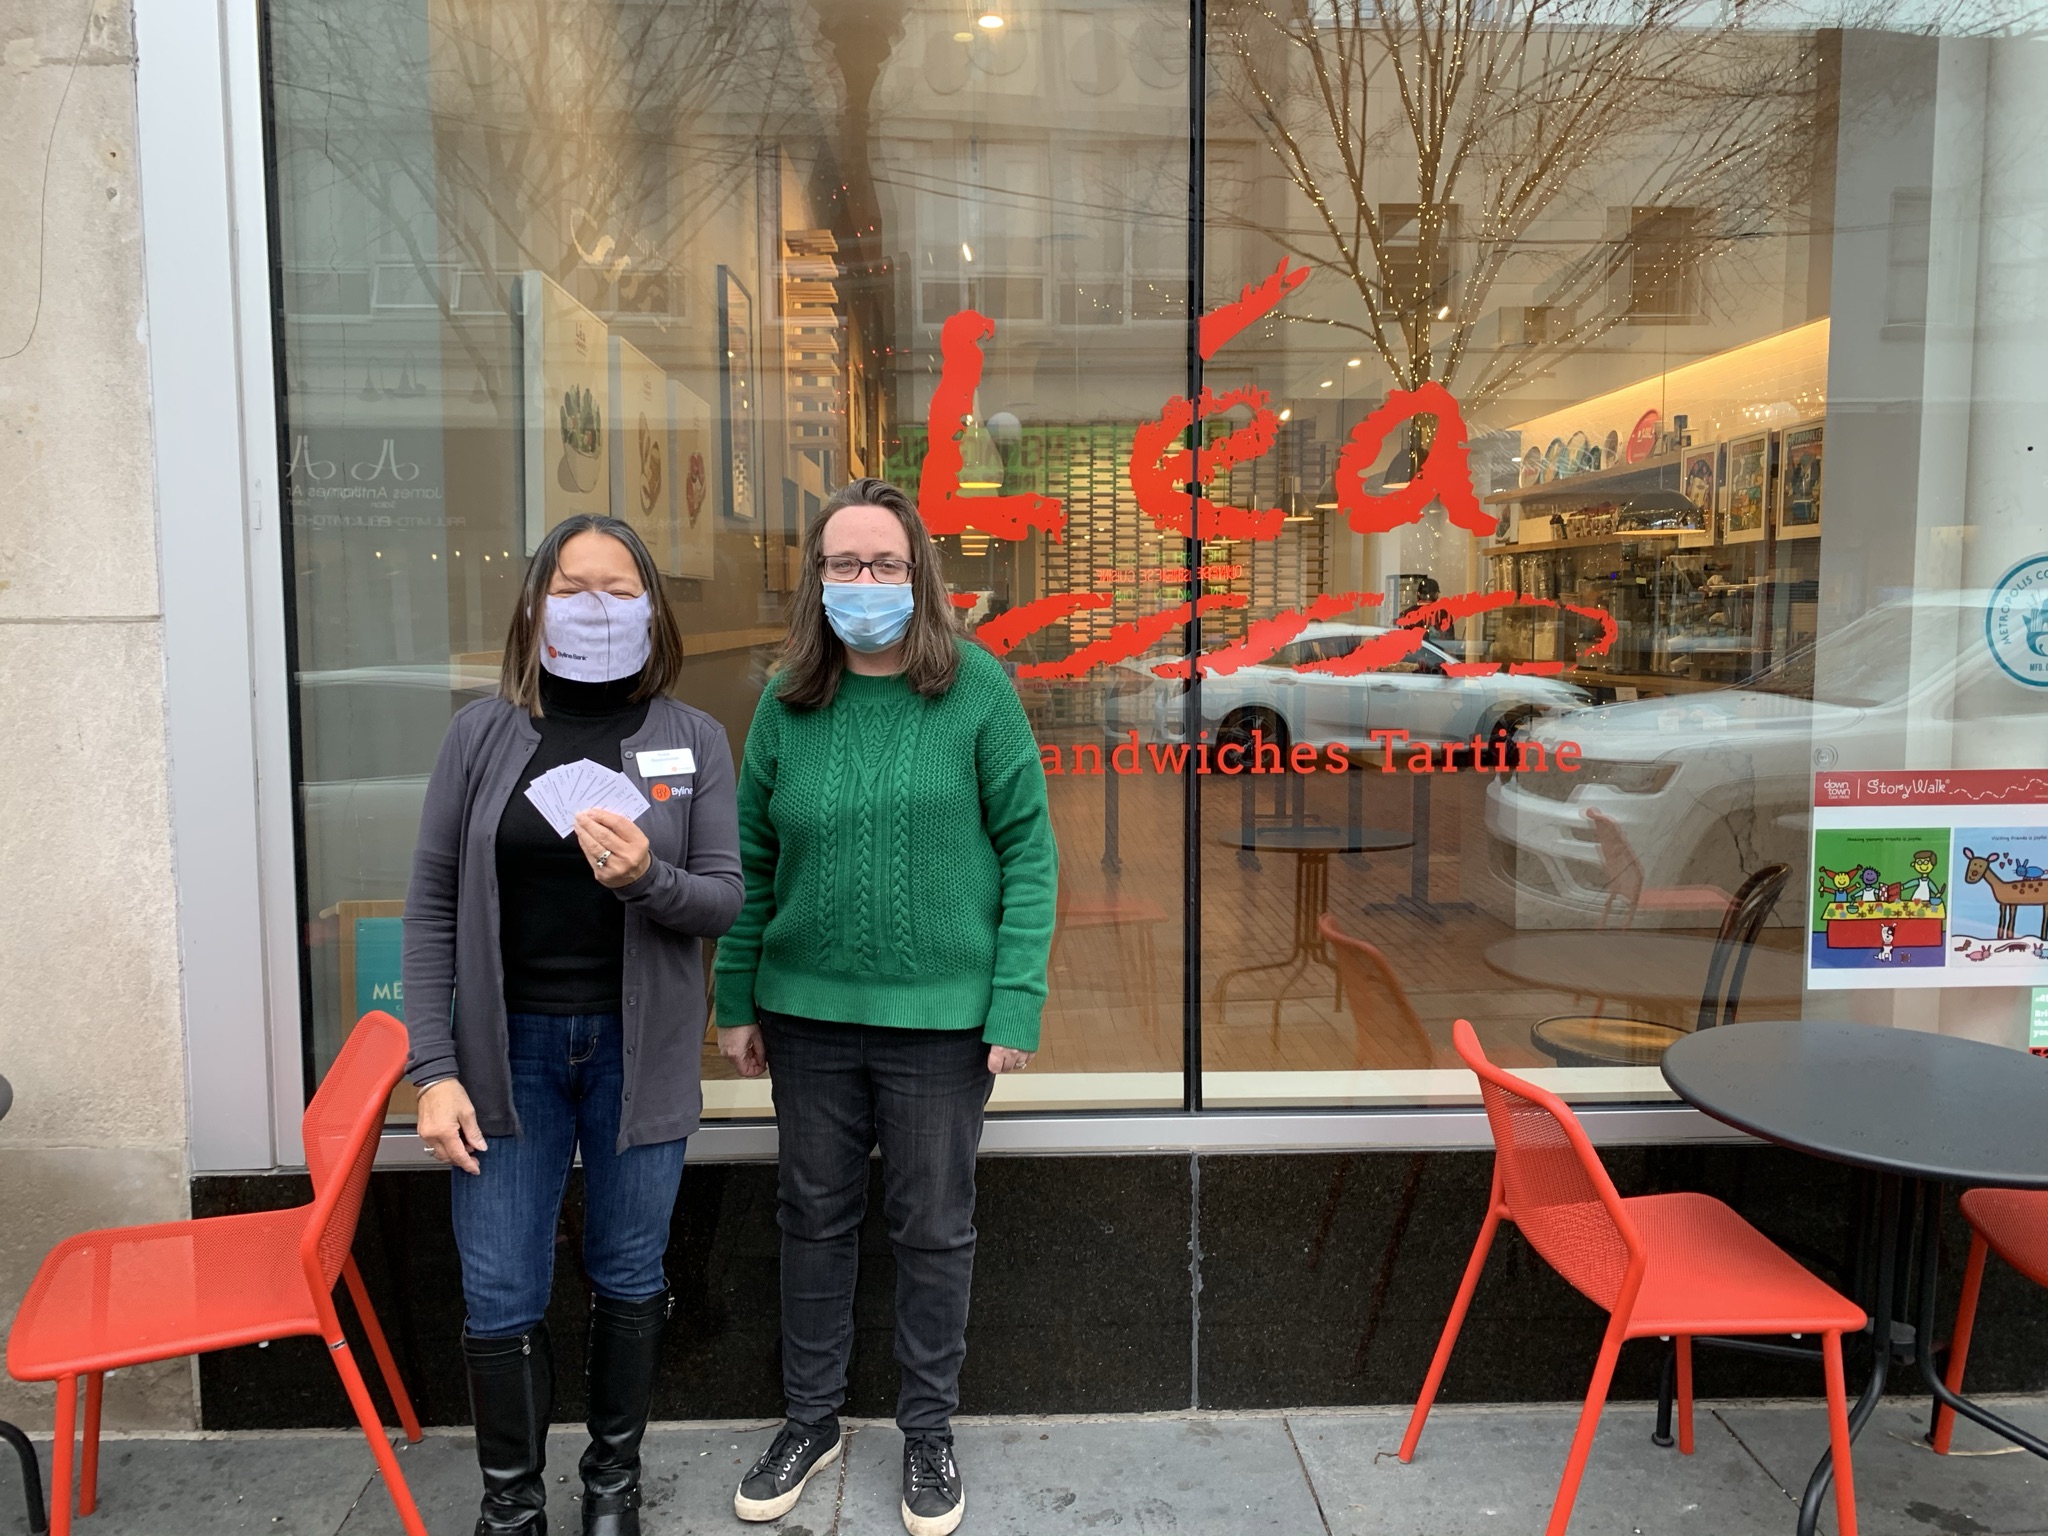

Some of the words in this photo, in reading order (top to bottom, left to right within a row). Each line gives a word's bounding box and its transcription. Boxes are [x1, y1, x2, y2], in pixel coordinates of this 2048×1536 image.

[918, 255, 1499, 544] Léa
[1999, 575, 2032, 645] METROPOLIS
[1039, 730, 1349, 775] andwiches
[1370, 729, 1583, 774] Tartine
[1823, 779, 1849, 789] down
[1828, 787, 1851, 796] town
